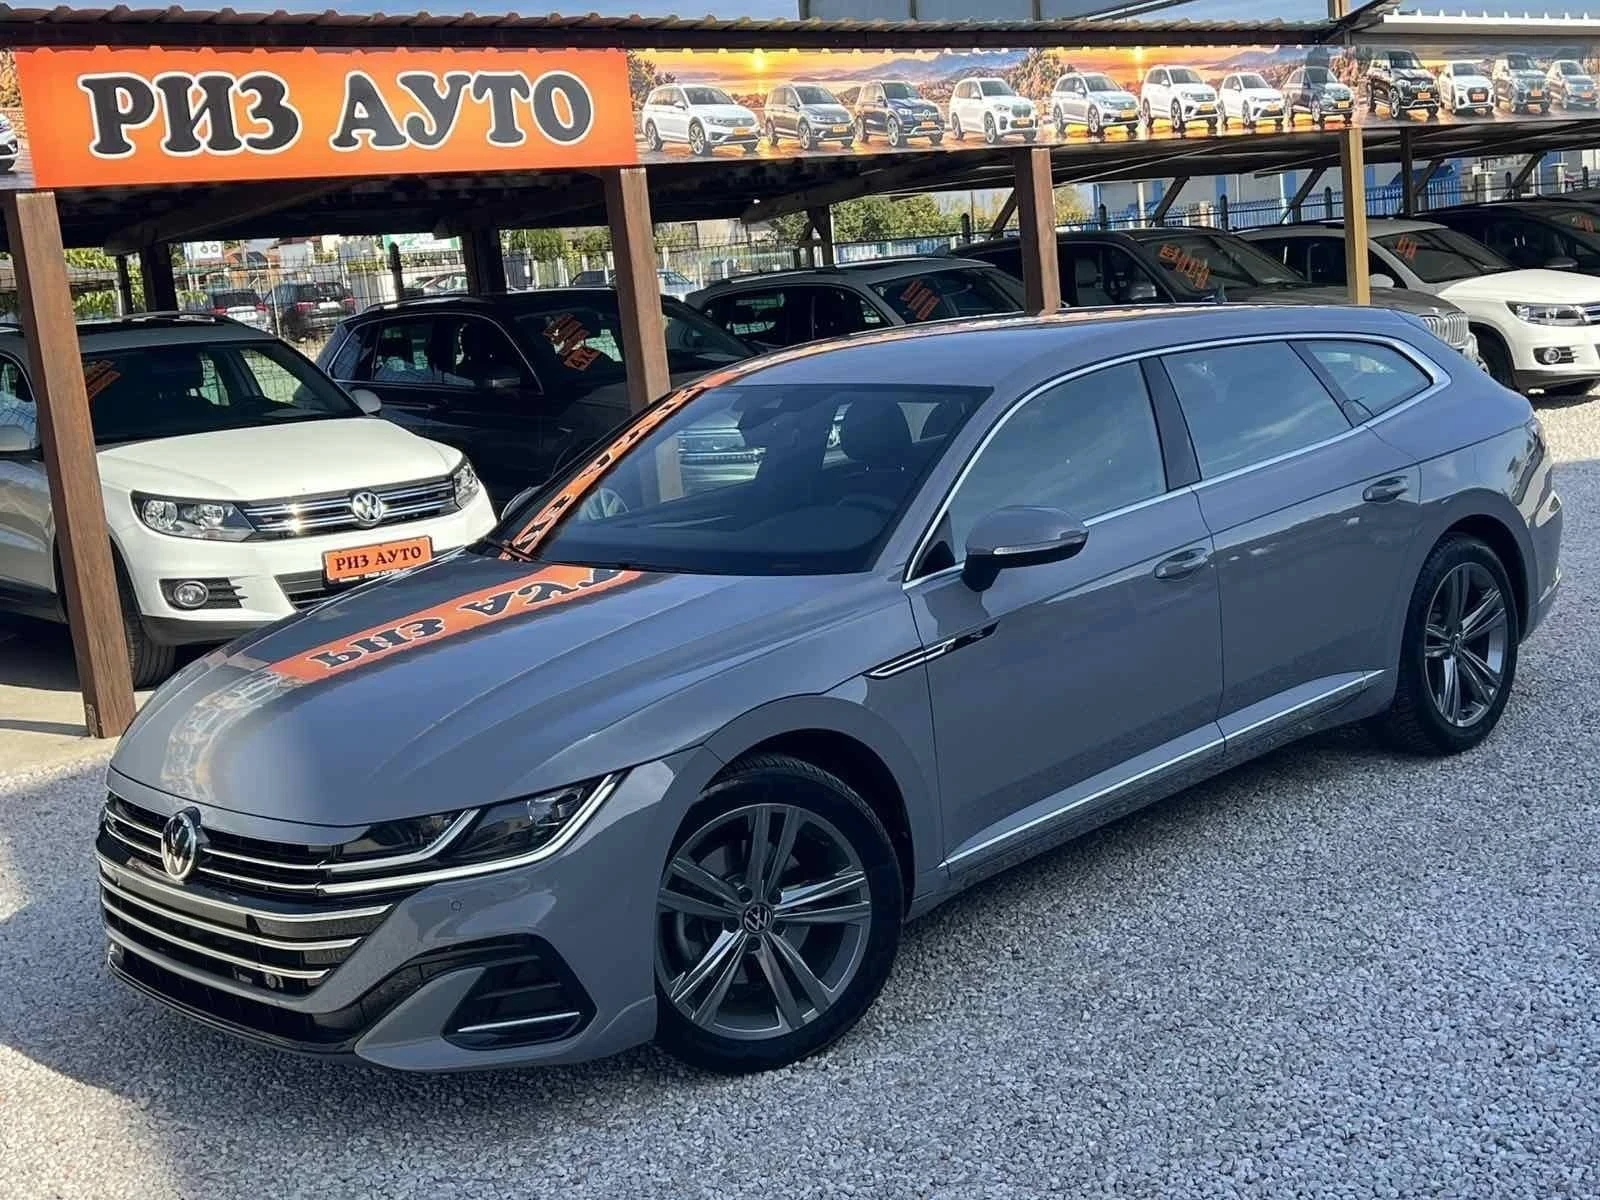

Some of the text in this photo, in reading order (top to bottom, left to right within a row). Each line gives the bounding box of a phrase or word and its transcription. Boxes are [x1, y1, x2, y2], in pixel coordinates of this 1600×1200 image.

[79, 71, 596, 160] РИЗ АУТО
[335, 546, 422, 572] РИЗ АУТО
